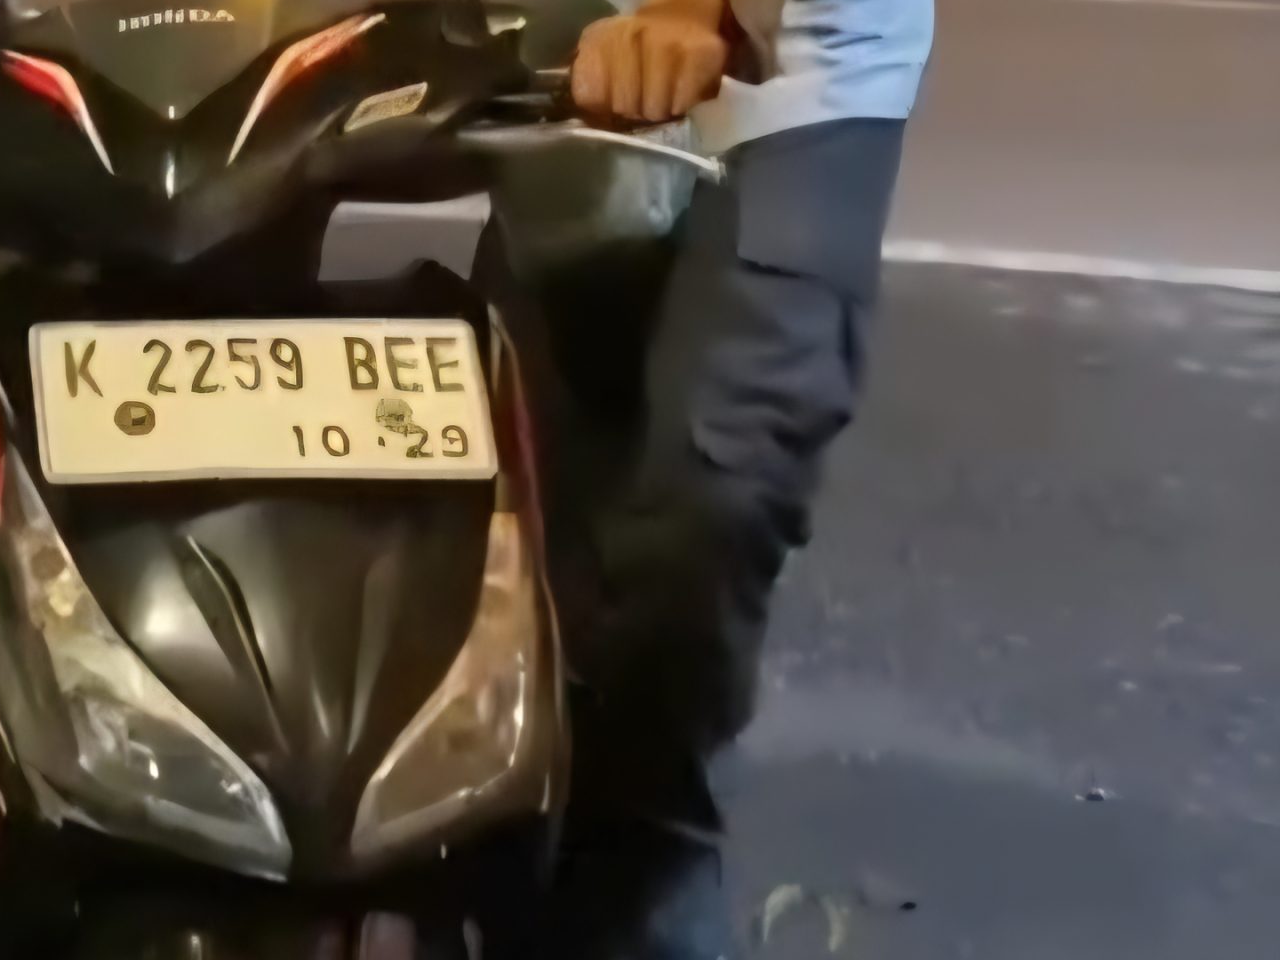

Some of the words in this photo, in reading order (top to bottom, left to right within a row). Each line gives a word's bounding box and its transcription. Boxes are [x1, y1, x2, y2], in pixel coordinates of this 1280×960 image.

[64, 340, 104, 398] K
[142, 338, 304, 395] 2259
[343, 337, 466, 392] BEE
